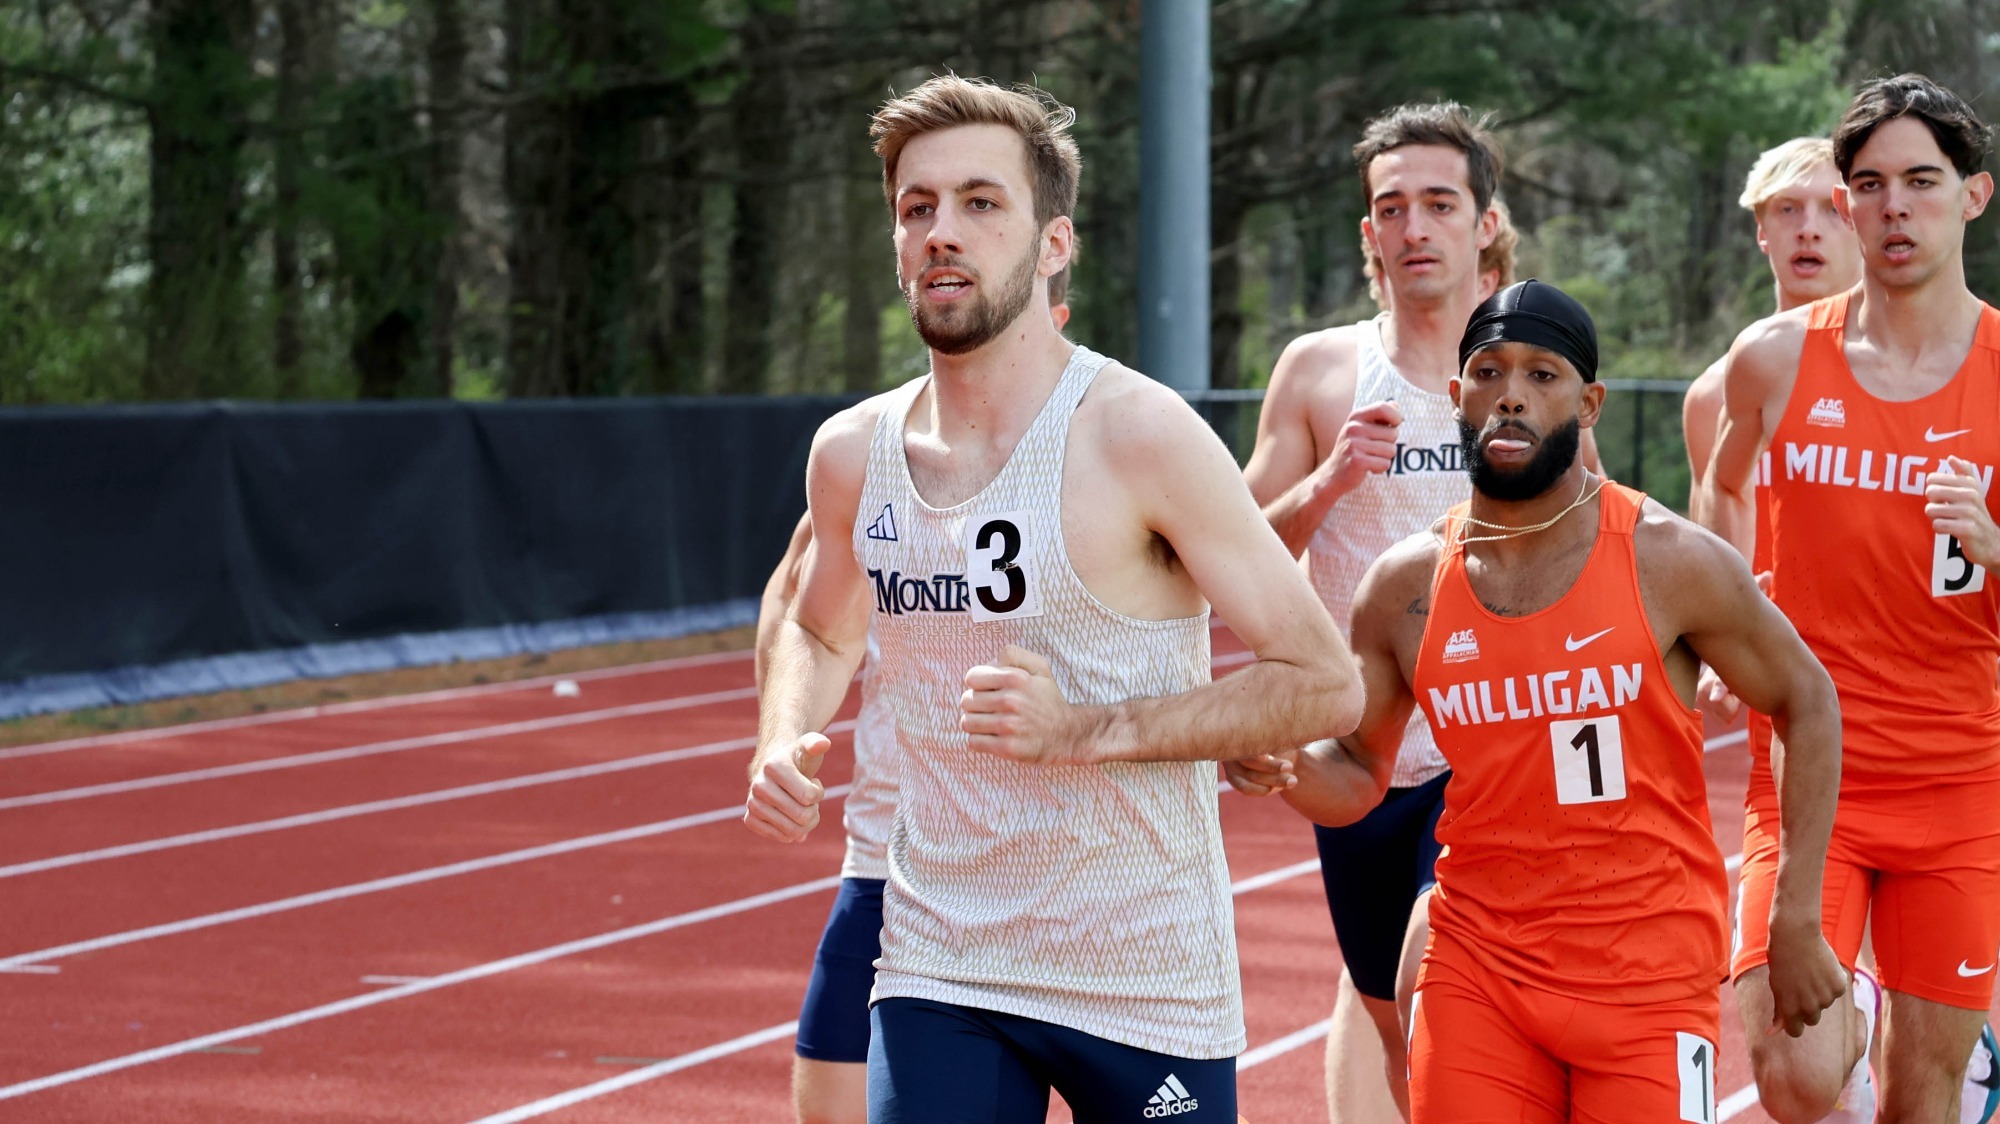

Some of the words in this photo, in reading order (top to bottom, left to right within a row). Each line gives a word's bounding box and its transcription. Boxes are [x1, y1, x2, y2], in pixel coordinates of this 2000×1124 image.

[1816, 397, 1843, 411] AAC
[975, 519, 1027, 614] 3
[1944, 534, 1975, 591] 5
[900, 623, 1003, 637] COLLEGE
[1450, 628, 1474, 645] AAC
[1427, 663, 1642, 728] MILLIGAN
[1570, 723, 1604, 797] 1
[1143, 1098, 1199, 1118] adidas
[1691, 1044, 1708, 1122] 1
